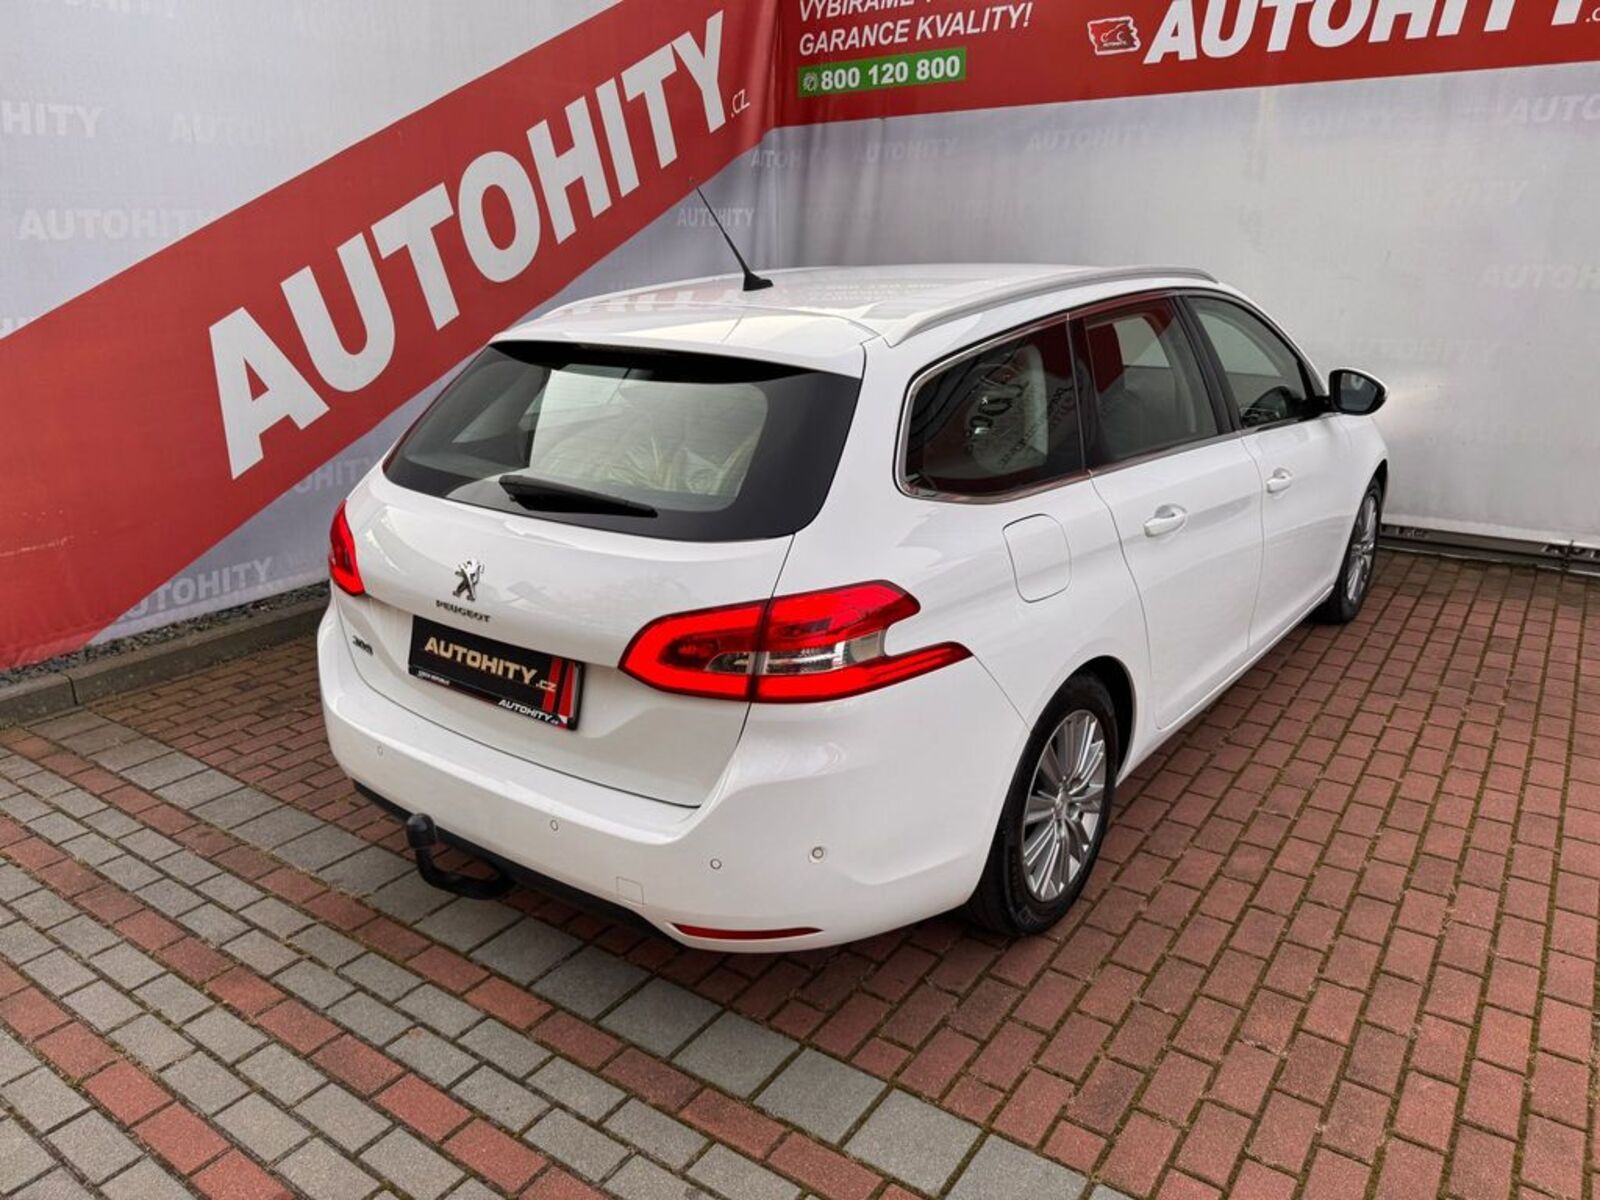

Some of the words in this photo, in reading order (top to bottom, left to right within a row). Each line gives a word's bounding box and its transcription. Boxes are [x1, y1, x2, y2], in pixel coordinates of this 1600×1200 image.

[799, 18, 911, 56] GARANCE
[915, 2, 1034, 41] KVALITY!
[821, 68, 861, 91] 800
[868, 60, 909, 86] 120
[916, 55, 961, 81] 800
[436, 600, 491, 622] PEUGEOT
